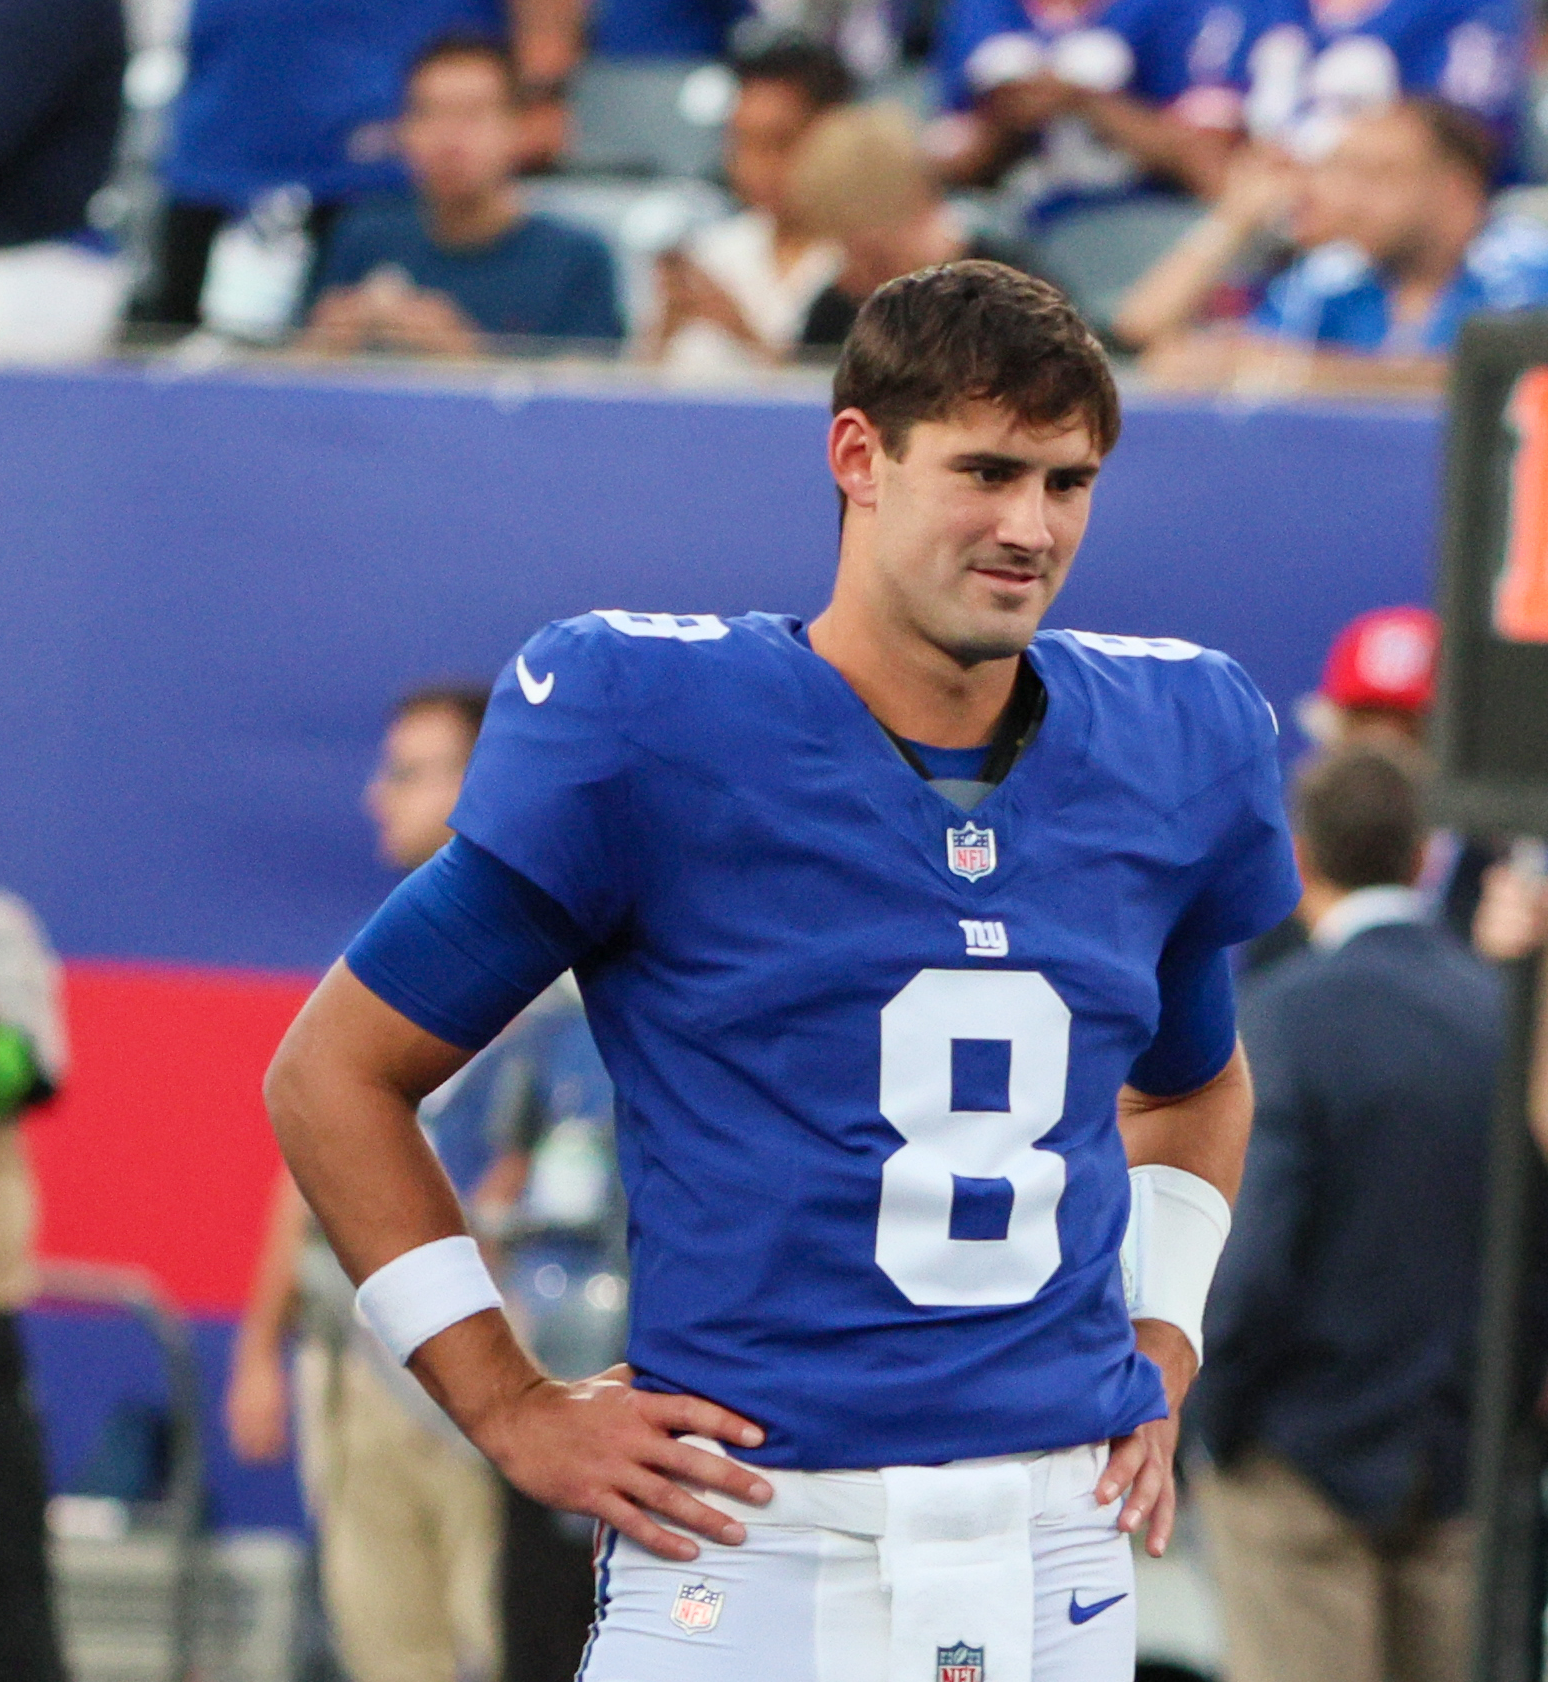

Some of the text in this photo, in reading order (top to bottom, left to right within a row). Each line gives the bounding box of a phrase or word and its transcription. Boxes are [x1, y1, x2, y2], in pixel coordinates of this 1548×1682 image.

[957, 849, 987, 870] NFL
[875, 969, 1072, 1307] 8
[679, 1600, 711, 1625] NFL
